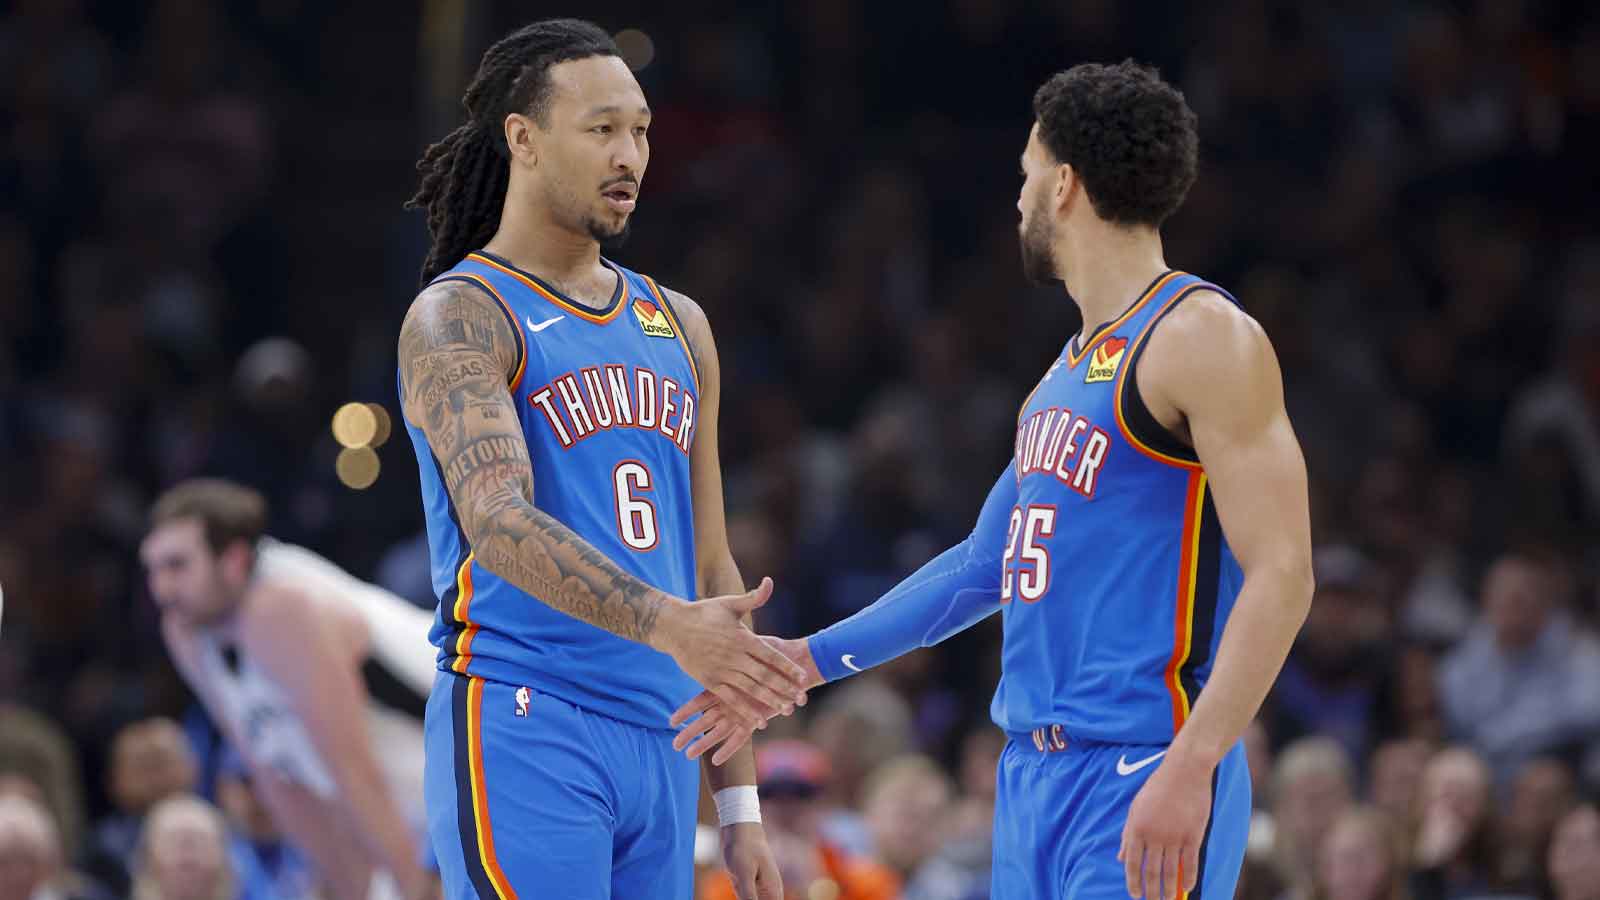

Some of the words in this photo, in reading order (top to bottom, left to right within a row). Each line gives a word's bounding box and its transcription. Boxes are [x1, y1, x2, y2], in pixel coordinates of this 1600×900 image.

[528, 364, 693, 458] THUNDER
[1088, 365, 1114, 379] Love's
[612, 458, 660, 552] 6
[1001, 504, 1056, 604] 25
